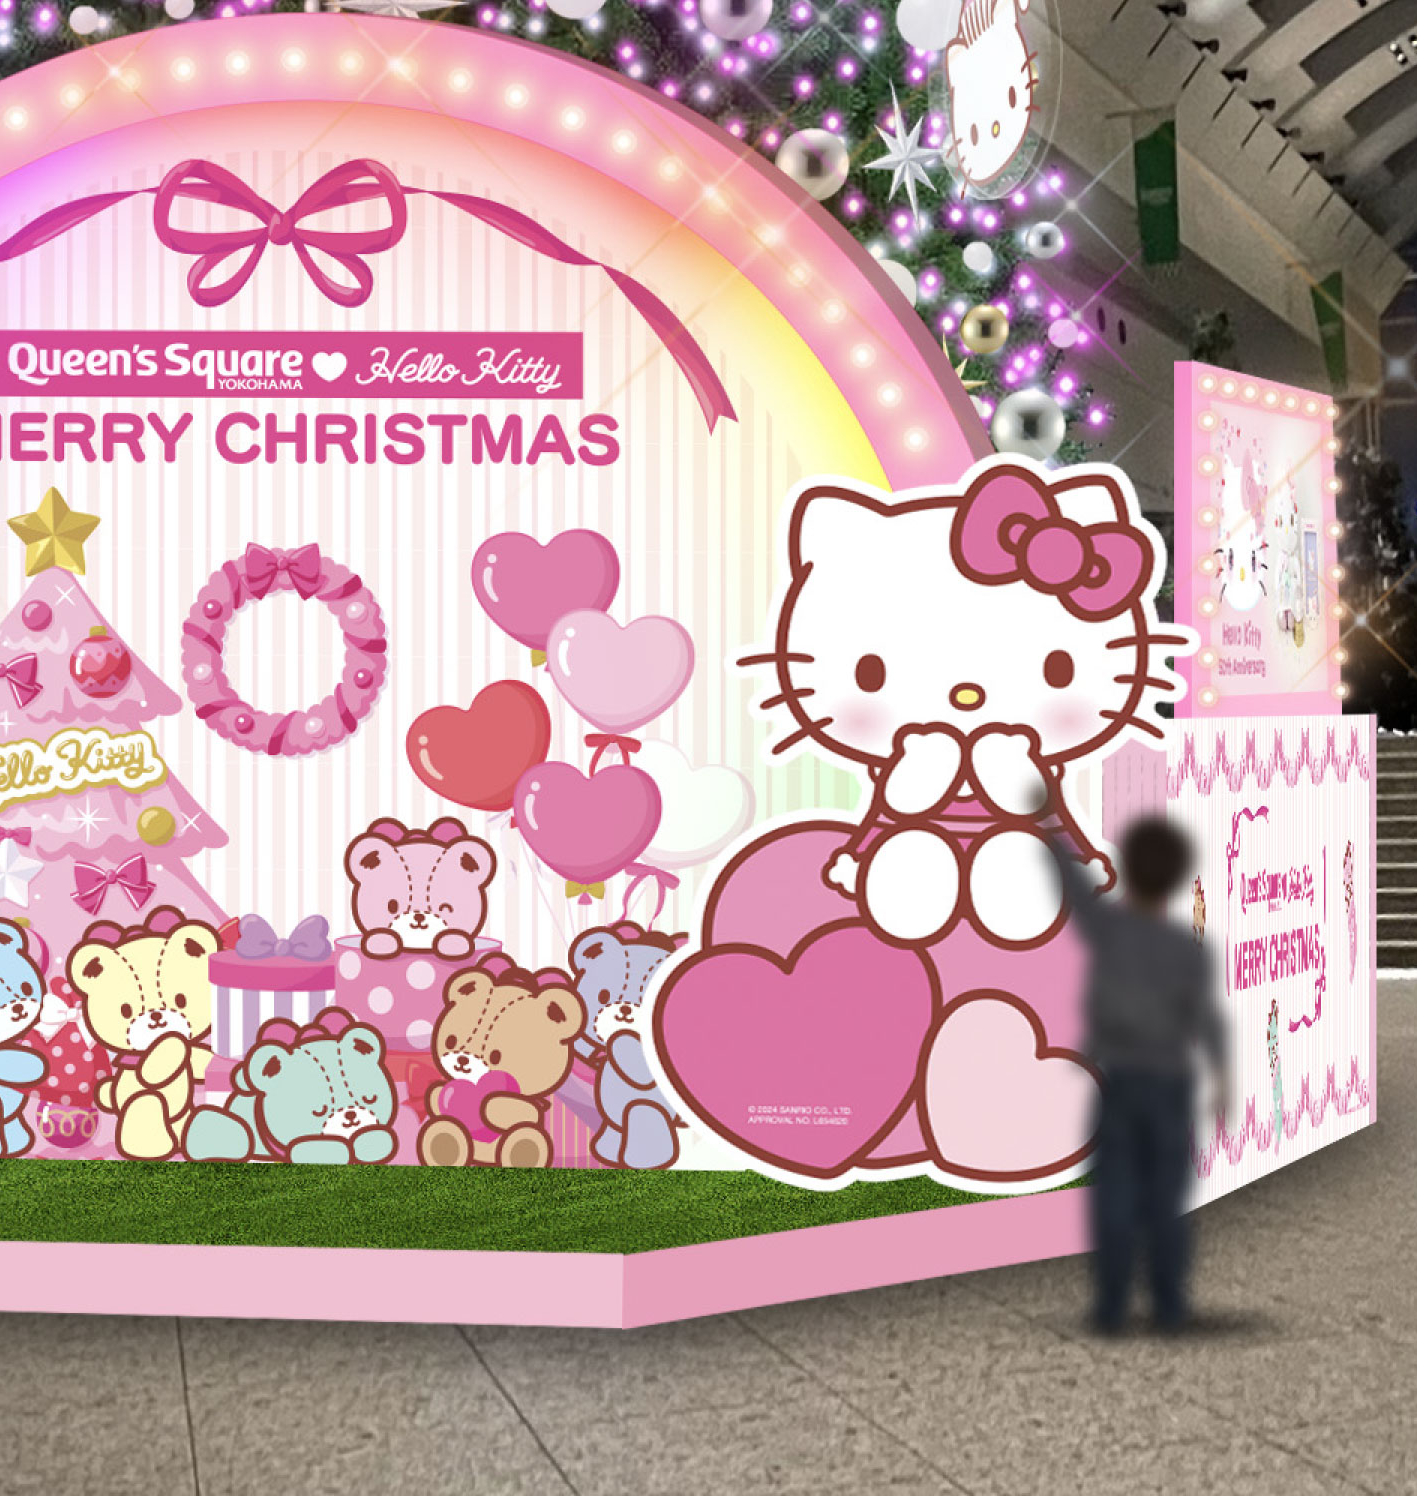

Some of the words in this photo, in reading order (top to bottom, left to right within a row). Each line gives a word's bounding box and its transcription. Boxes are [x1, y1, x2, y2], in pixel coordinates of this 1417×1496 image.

[8, 342, 158, 385] Queen's
[164, 342, 303, 390] Square
[355, 346, 460, 385] Hello
[460, 346, 563, 393] Kitty
[217, 379, 304, 391] YOKOHAMA
[215, 412, 620, 466] CHRISTMAS
[55, 737, 156, 782] Kitty
[1233, 935, 1268, 991] MERRY
[1269, 922, 1321, 983] CHRISTMAS
[747, 1116, 794, 1125] APPROVAL
[779, 1105, 813, 1115] SANRIO
